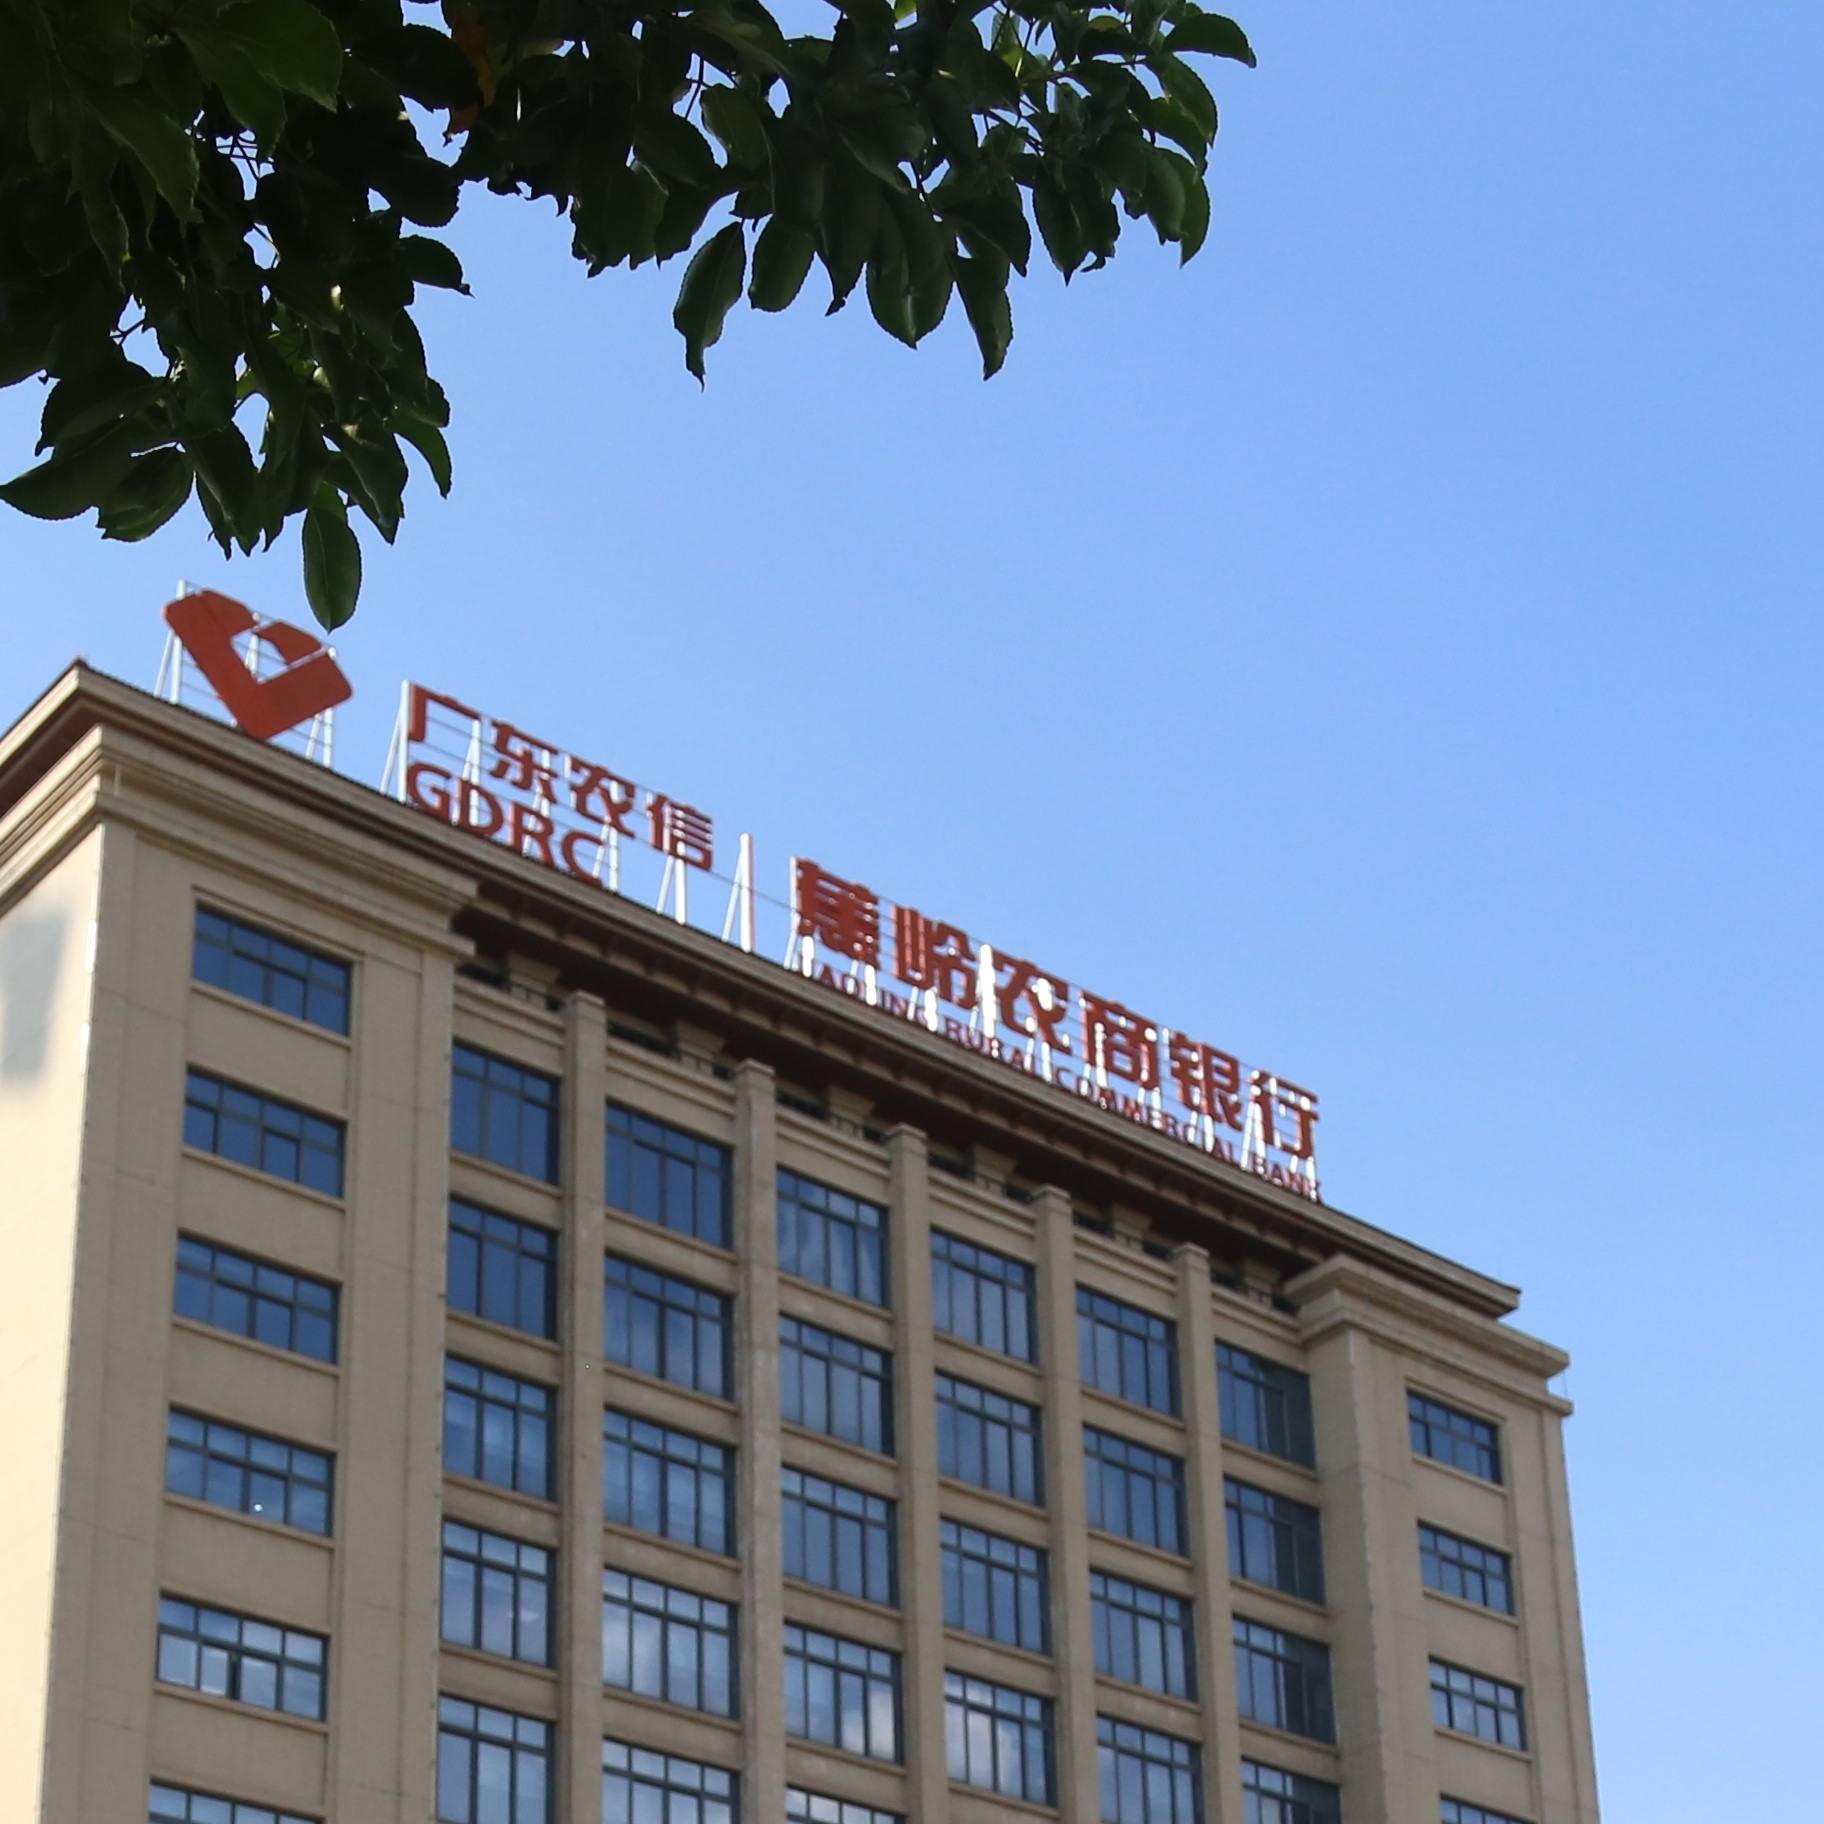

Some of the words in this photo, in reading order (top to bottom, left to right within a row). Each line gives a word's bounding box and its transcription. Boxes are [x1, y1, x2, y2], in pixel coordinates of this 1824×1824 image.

[406, 761, 605, 890] GDRC
[407, 682, 713, 872] 广东农信
[796, 857, 1320, 1160] 蕉岭农商银行
